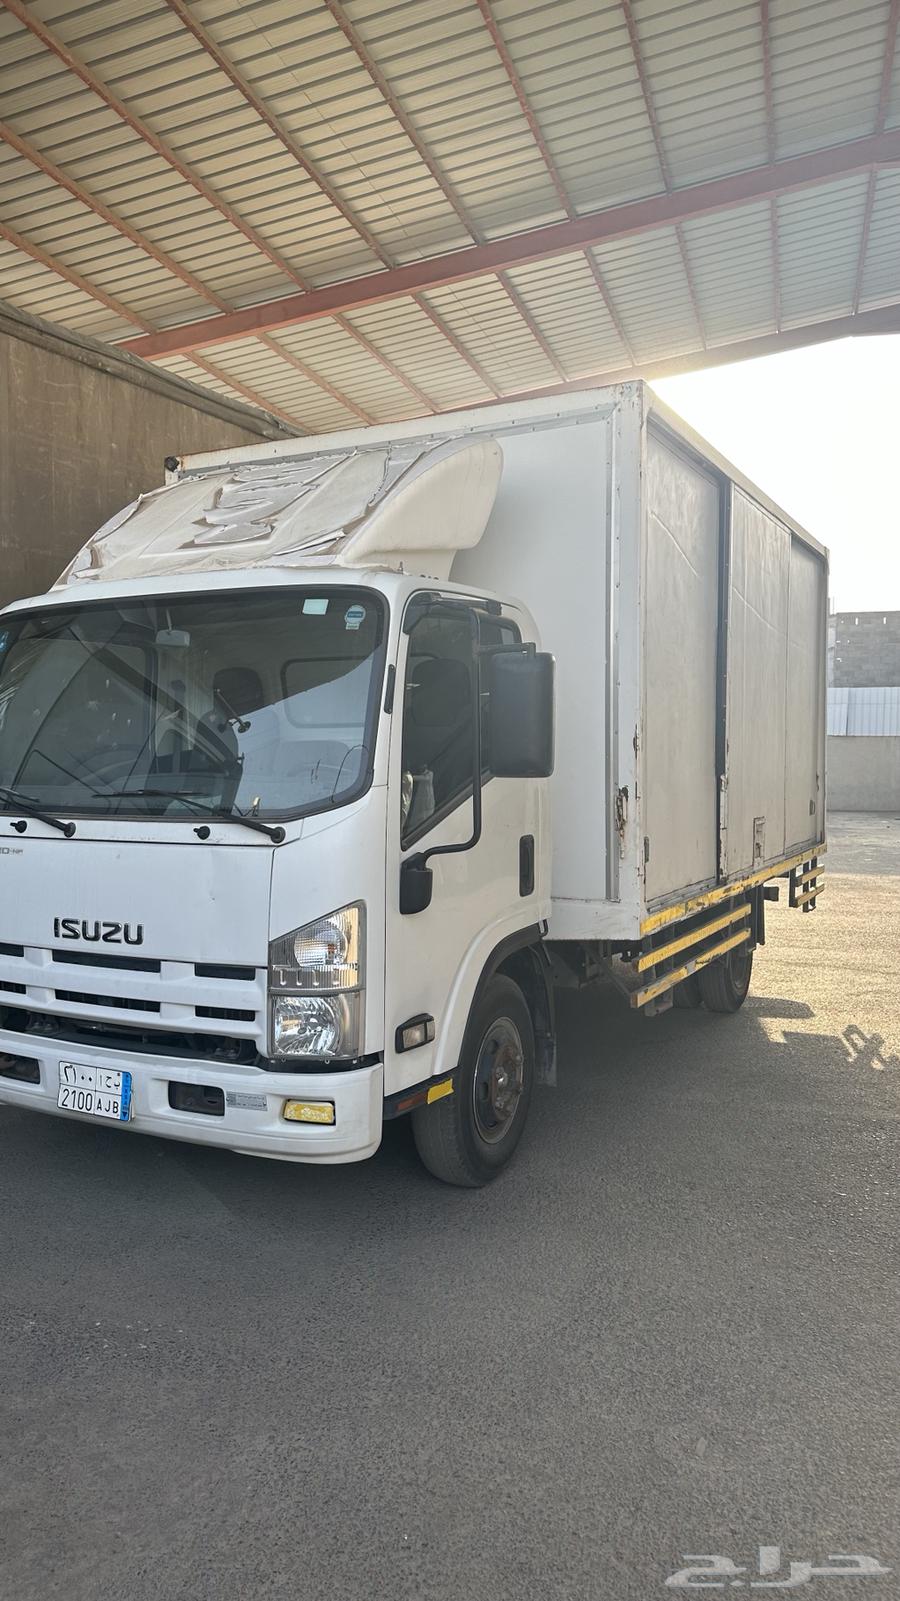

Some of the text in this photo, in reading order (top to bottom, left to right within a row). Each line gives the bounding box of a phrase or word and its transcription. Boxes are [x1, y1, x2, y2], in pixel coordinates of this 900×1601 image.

[54, 917, 144, 945] ISUZU
[62, 1088, 119, 1114] 2100 AJB
